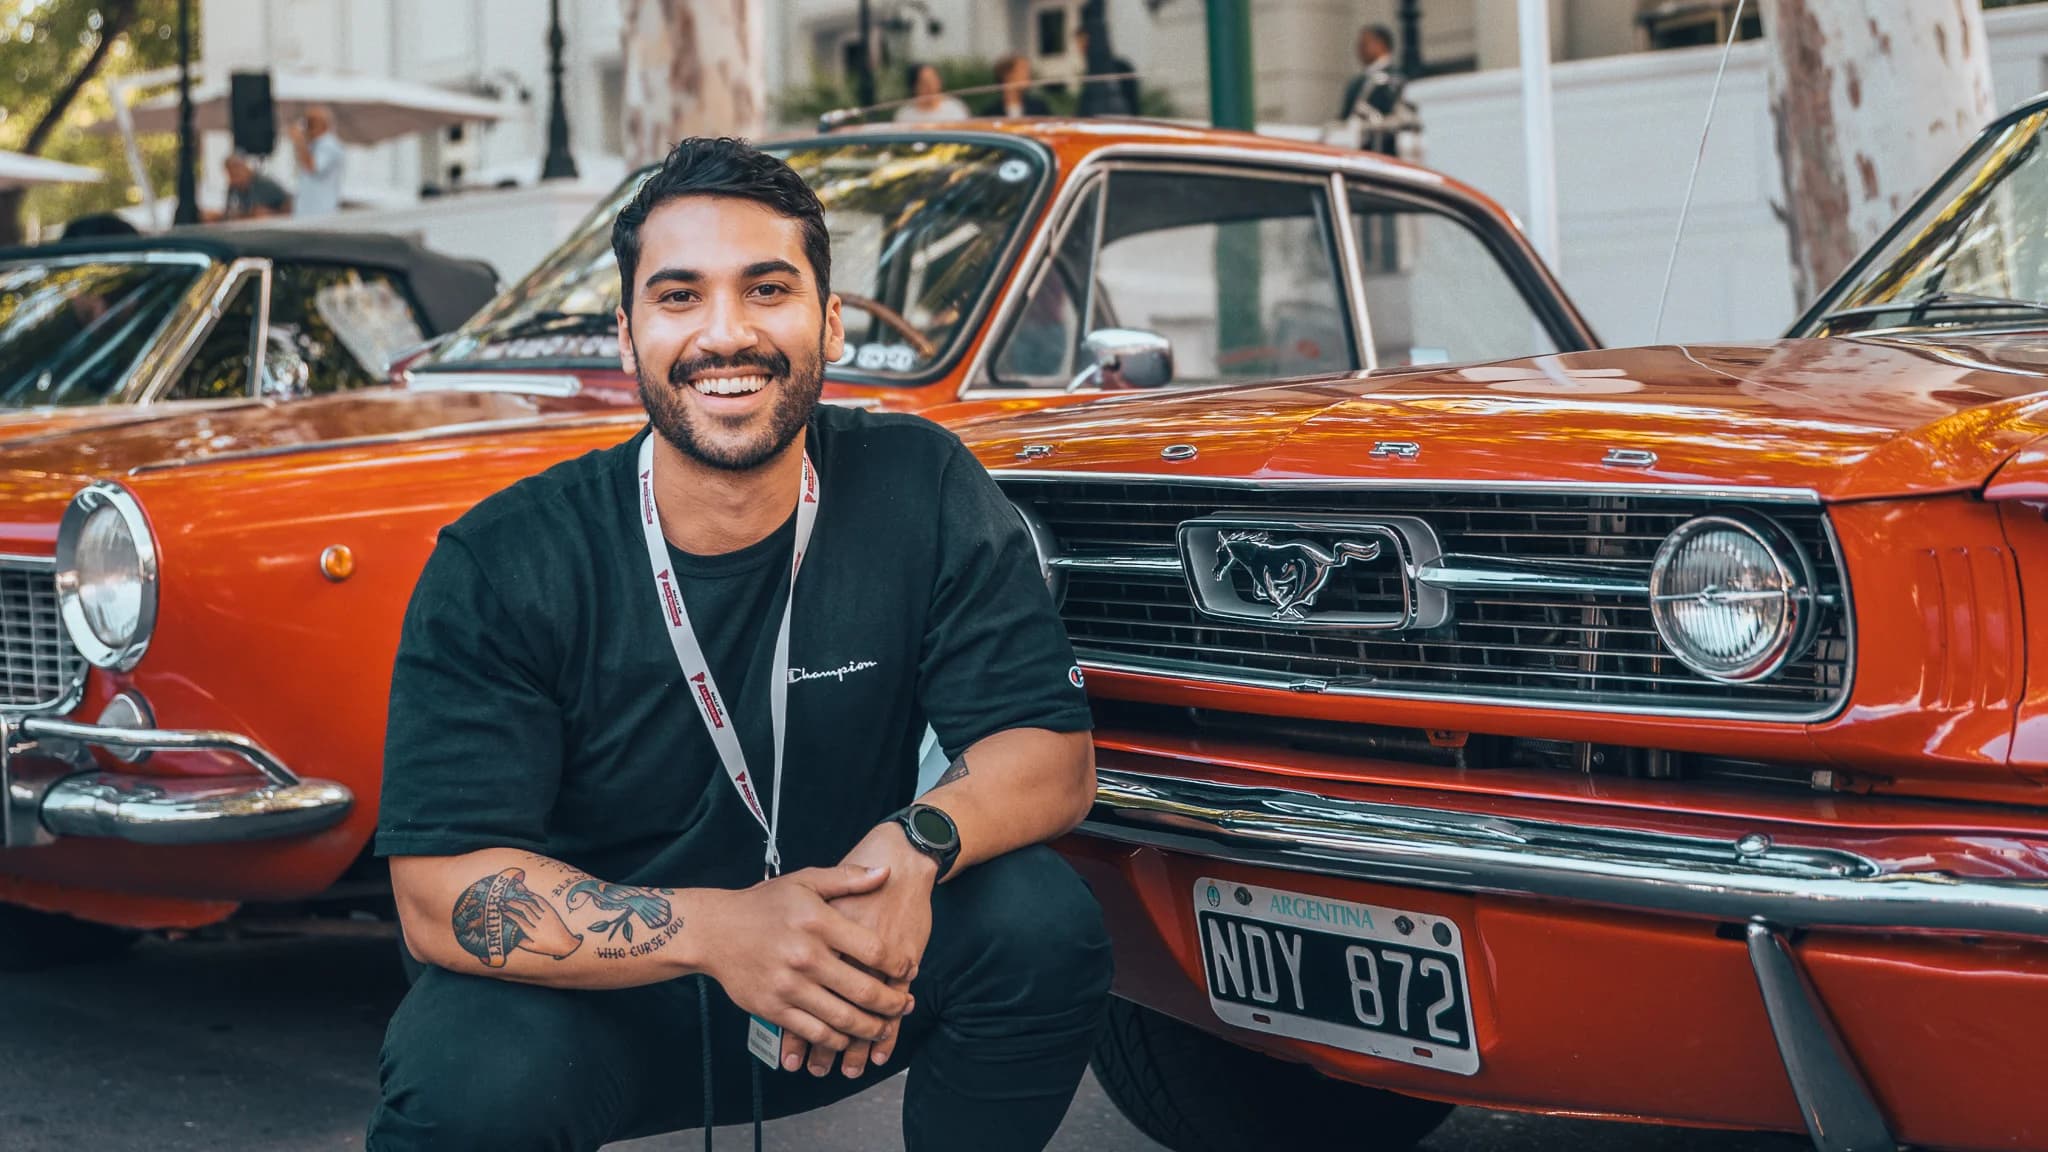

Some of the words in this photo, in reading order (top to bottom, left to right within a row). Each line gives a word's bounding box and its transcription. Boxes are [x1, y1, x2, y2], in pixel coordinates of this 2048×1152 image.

[787, 660, 878, 684] Champion
[1270, 894, 1375, 930] ARGENTINA
[597, 946, 626, 959] WHO
[630, 934, 666, 957] CURSE
[664, 916, 684, 940] YOU
[1208, 918, 1304, 1010] NDY
[1345, 945, 1460, 1043] 872
